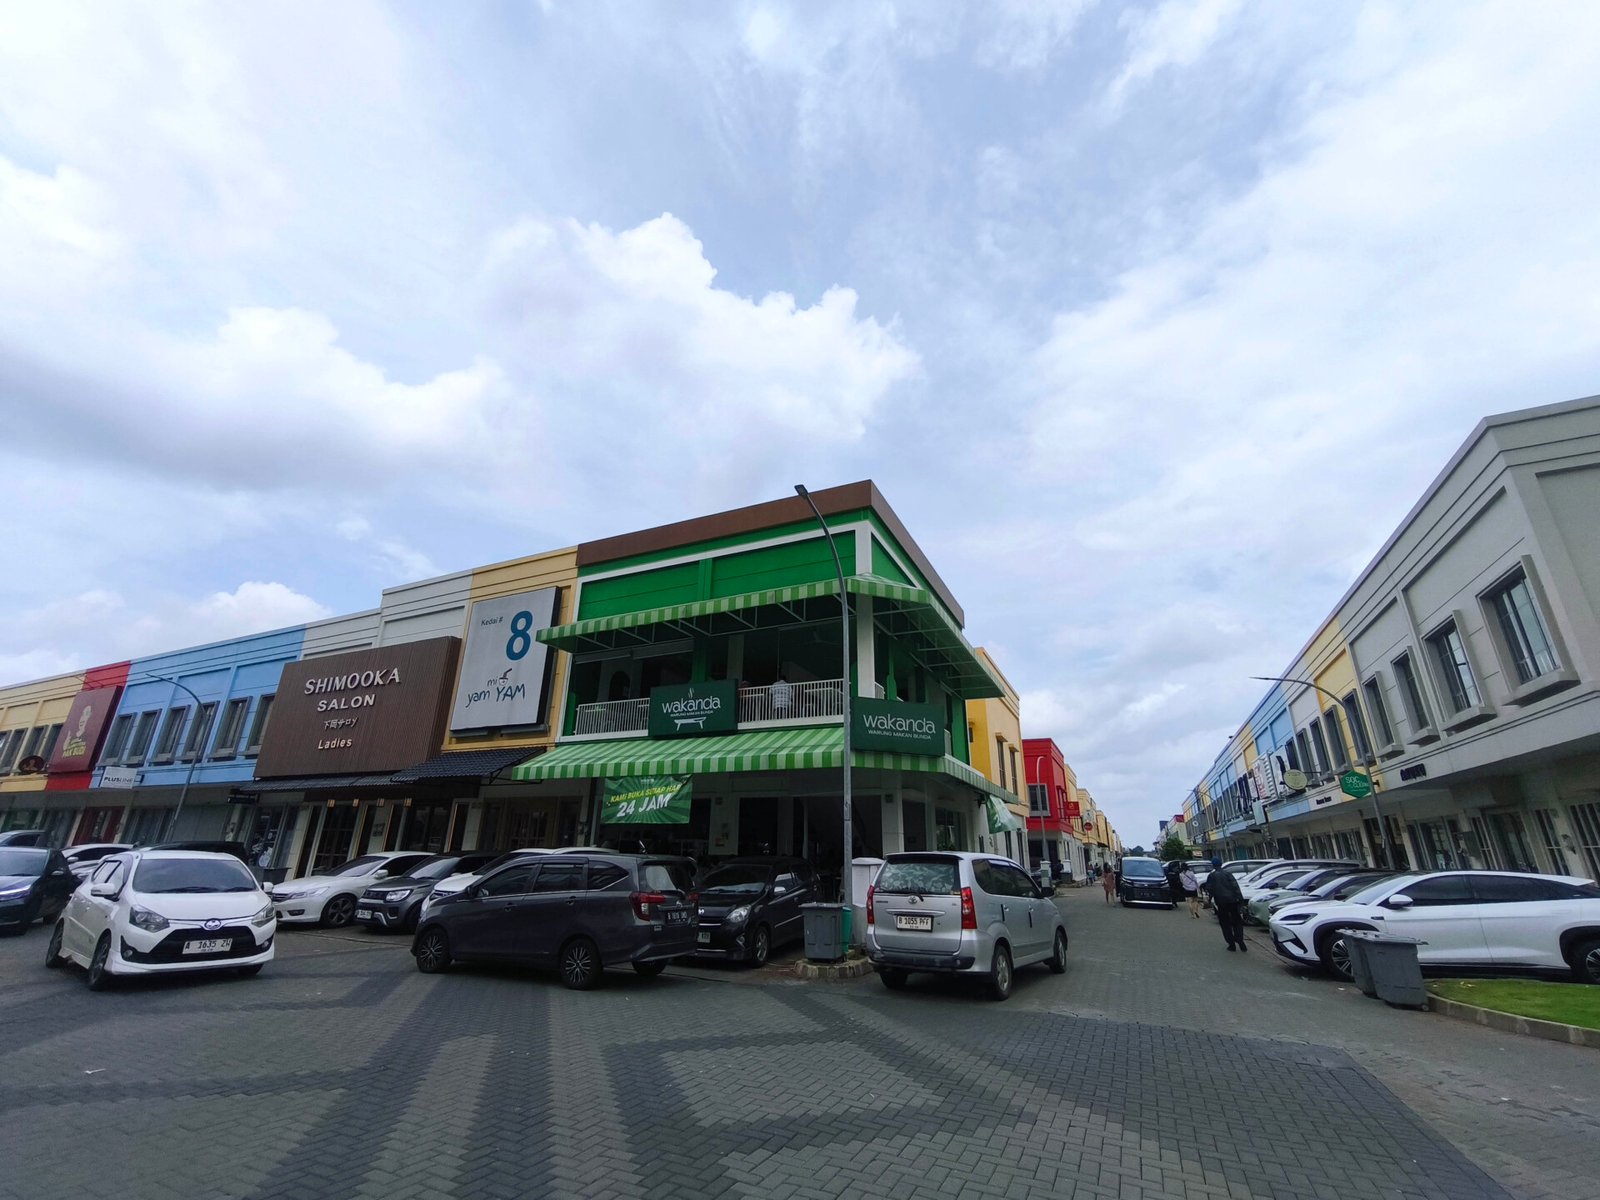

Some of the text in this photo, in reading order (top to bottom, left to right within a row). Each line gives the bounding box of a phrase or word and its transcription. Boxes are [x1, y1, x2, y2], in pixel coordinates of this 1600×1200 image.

[481, 616, 498, 627] Kedai
[505, 610, 533, 661] 8
[304, 667, 401, 695] SHIMOOKA
[487, 676, 498, 687] mi
[317, 694, 376, 712] SALON
[465, 683, 526, 708] yam YAM
[661, 695, 721, 714] wakanda
[862, 713, 936, 734] wakanda
[867, 729, 892, 737] WARUNG
[893, 731, 913, 739] MAKAN
[317, 737, 353, 750] Ladies
[627, 789, 644, 800] BUKA
[616, 793, 674, 817] 24 JAM
